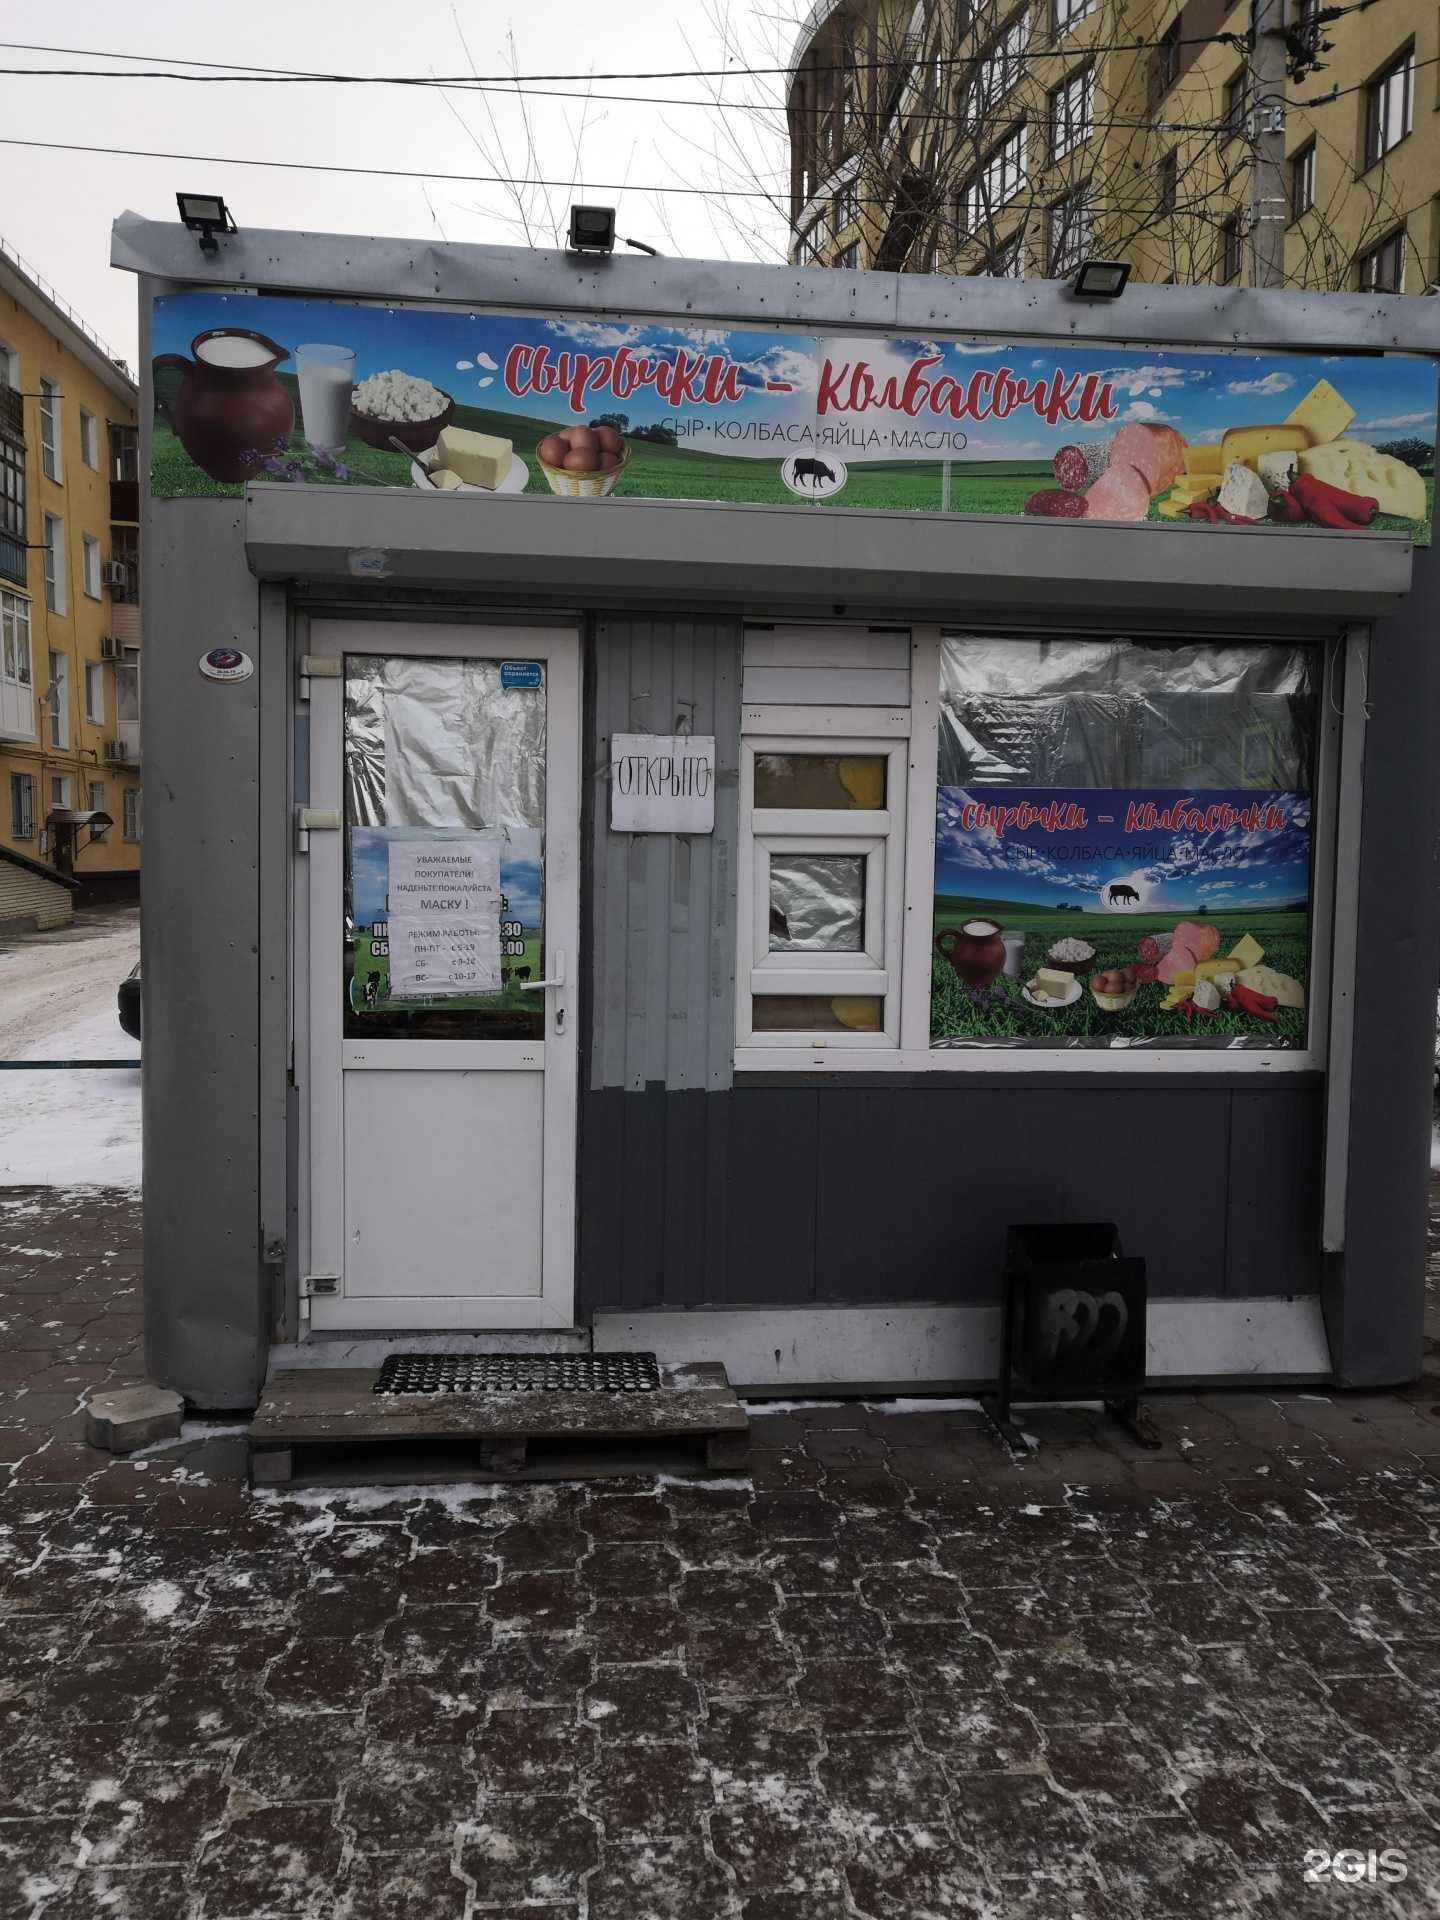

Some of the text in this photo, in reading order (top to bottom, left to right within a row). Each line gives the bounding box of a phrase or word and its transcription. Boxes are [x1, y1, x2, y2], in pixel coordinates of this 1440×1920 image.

[816, 353, 1119, 425] Колбасочки
[713, 420, 815, 443] КОЛБАСА
[821, 422, 881, 451] ЯЙЦА
[890, 429, 968, 451] МАСЛО
[618, 755, 709, 797] ОТКРЫТО
[416, 855, 473, 864] УВАЖАЕМЫЕ
[414, 870, 474, 879] ПОКУПАТЕЛИ!
[420, 899, 462, 910] МАСКУ
